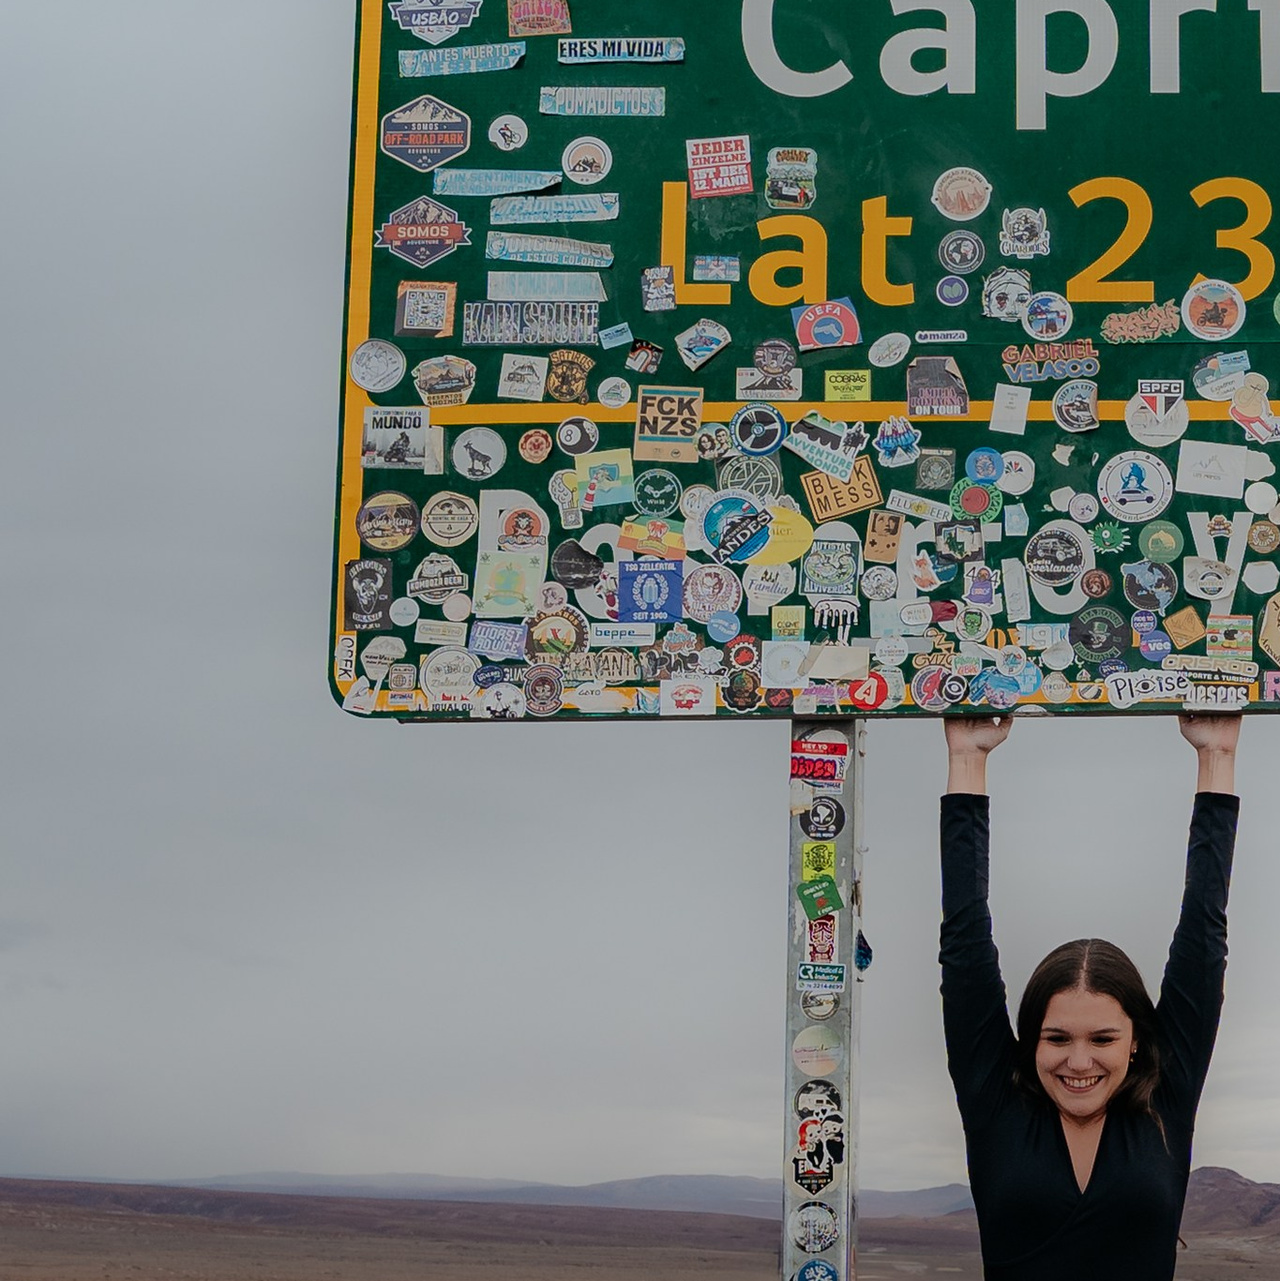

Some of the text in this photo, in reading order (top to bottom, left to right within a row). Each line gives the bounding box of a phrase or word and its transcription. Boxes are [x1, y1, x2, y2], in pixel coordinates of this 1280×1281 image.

[411, 8, 460, 25] USBÃO
[421, 45, 510, 64] ANTES MUERTO
[560, 41, 665, 58] ERES MI VIDA
[411, 122, 440, 131] SOMOS
[384, 133, 464, 145] OFF-ROAD PARK
[691, 140, 745, 156] JEDER
[692, 154, 746, 165] EINZELNE
[712, 175, 749, 187] MANN
[397, 225, 449, 238] SOMOS
[661, 182, 914, 306] Lat
[526, 253, 559, 263] ESTOS
[805, 306, 841, 321] UEFA
[463, 303, 599, 343] KARLSRUHE
[1001, 338, 1099, 362] GABRIEL
[829, 374, 867, 384] COBRAS
[1141, 383, 1181, 393] SPFC
[640, 396, 697, 416] FCK
[916, 406, 961, 415] ON TOUR
[372, 417, 422, 429] MUNDO
[640, 417, 697, 436] NZS
[788, 435, 853, 470] AVVENTURE
[806, 455, 848, 480] MONDO
[816, 482, 875, 515] MESS
[718, 511, 771, 561] ANDES
[633, 612, 648, 620] SEIT
[477, 626, 522, 641] WORST
[595, 627, 636, 639] beppe
[1217, 672, 1249, 681] TURISMO
[800, 966, 815, 979] CR
